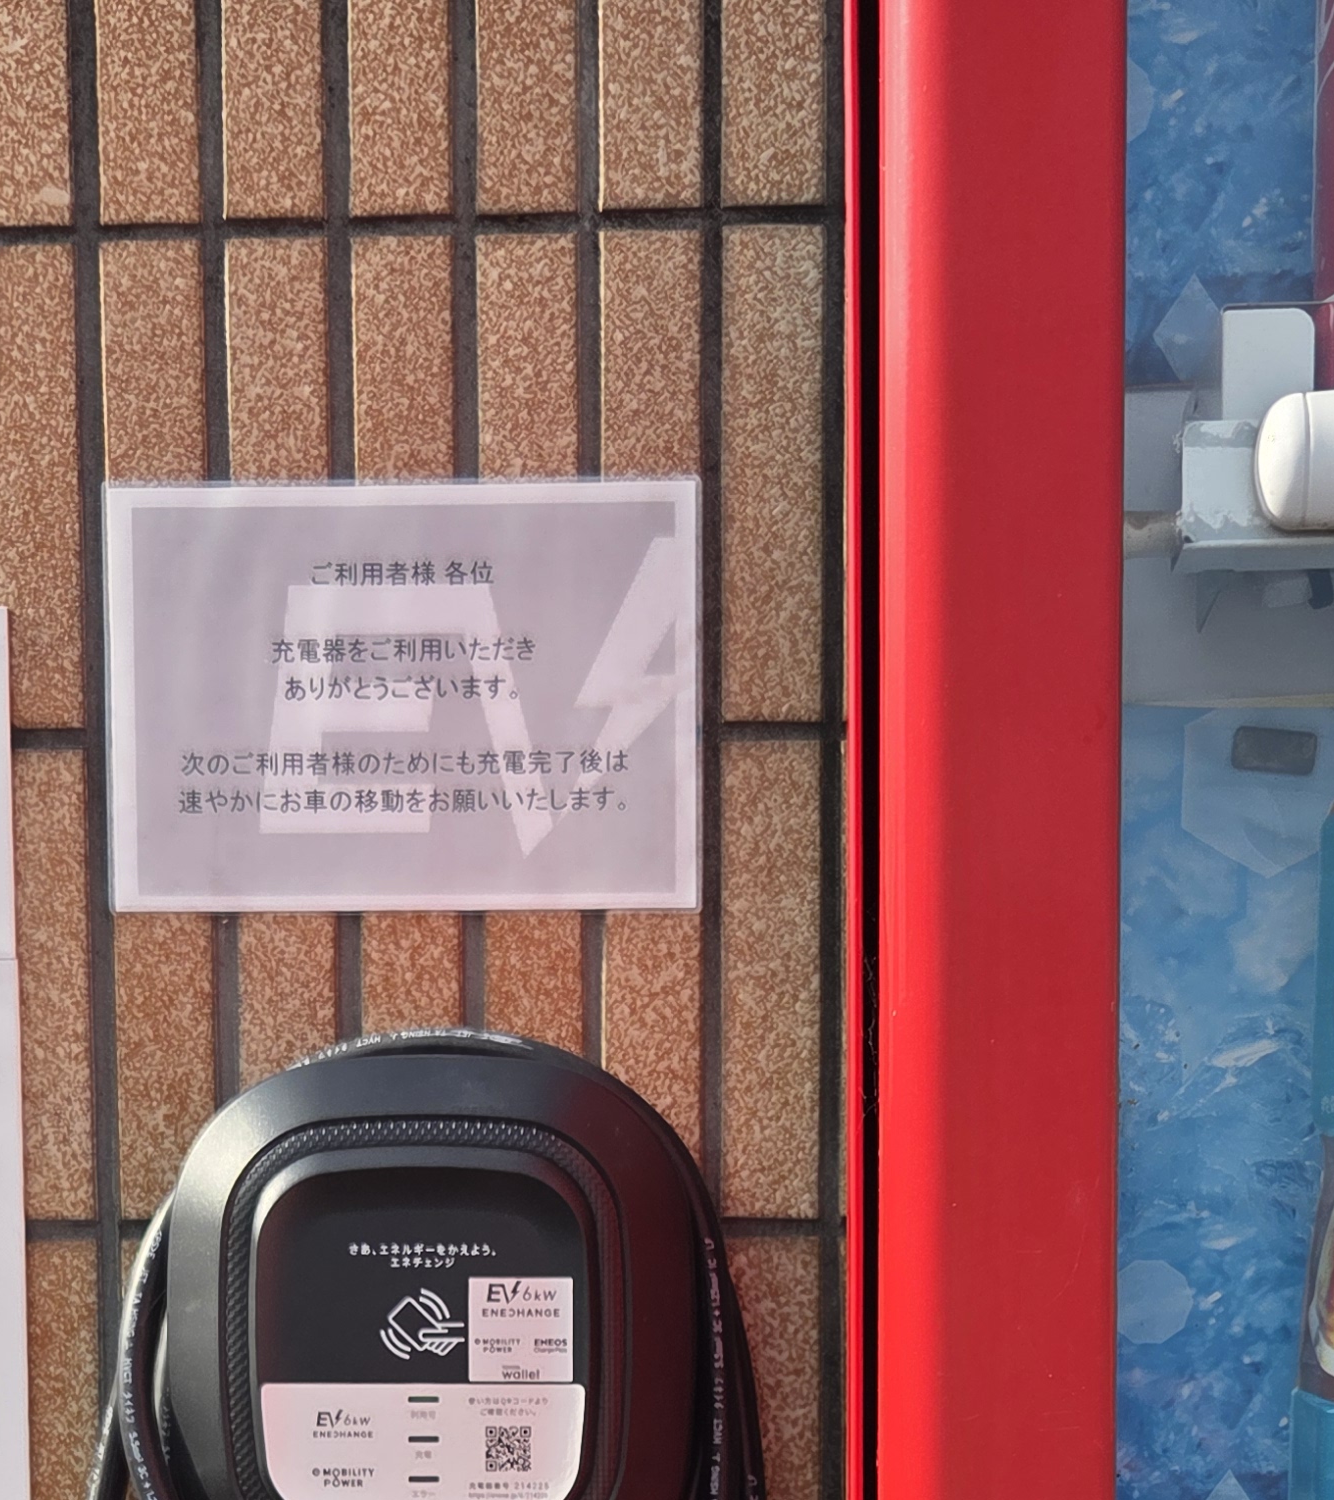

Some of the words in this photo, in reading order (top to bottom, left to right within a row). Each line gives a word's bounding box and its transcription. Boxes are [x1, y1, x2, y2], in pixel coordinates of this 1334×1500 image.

[311, 562, 436, 586] ご利用者様
[444, 561, 495, 585] 各位
[271, 638, 536, 664] 充電器をご利用いただき
[284, 675, 520, 700] ありがとうございます。
[181, 750, 629, 776] 次のご利用者様のためにも充電完了後は
[178, 786, 629, 814] 速やかにお車の移動をお願いいたします。
[349, 1243, 497, 1256] さあ、エネルギーをかえよう。
[390, 1257, 455, 1268] エネチェンジ
[523, 1286, 557, 1301] 6kW
